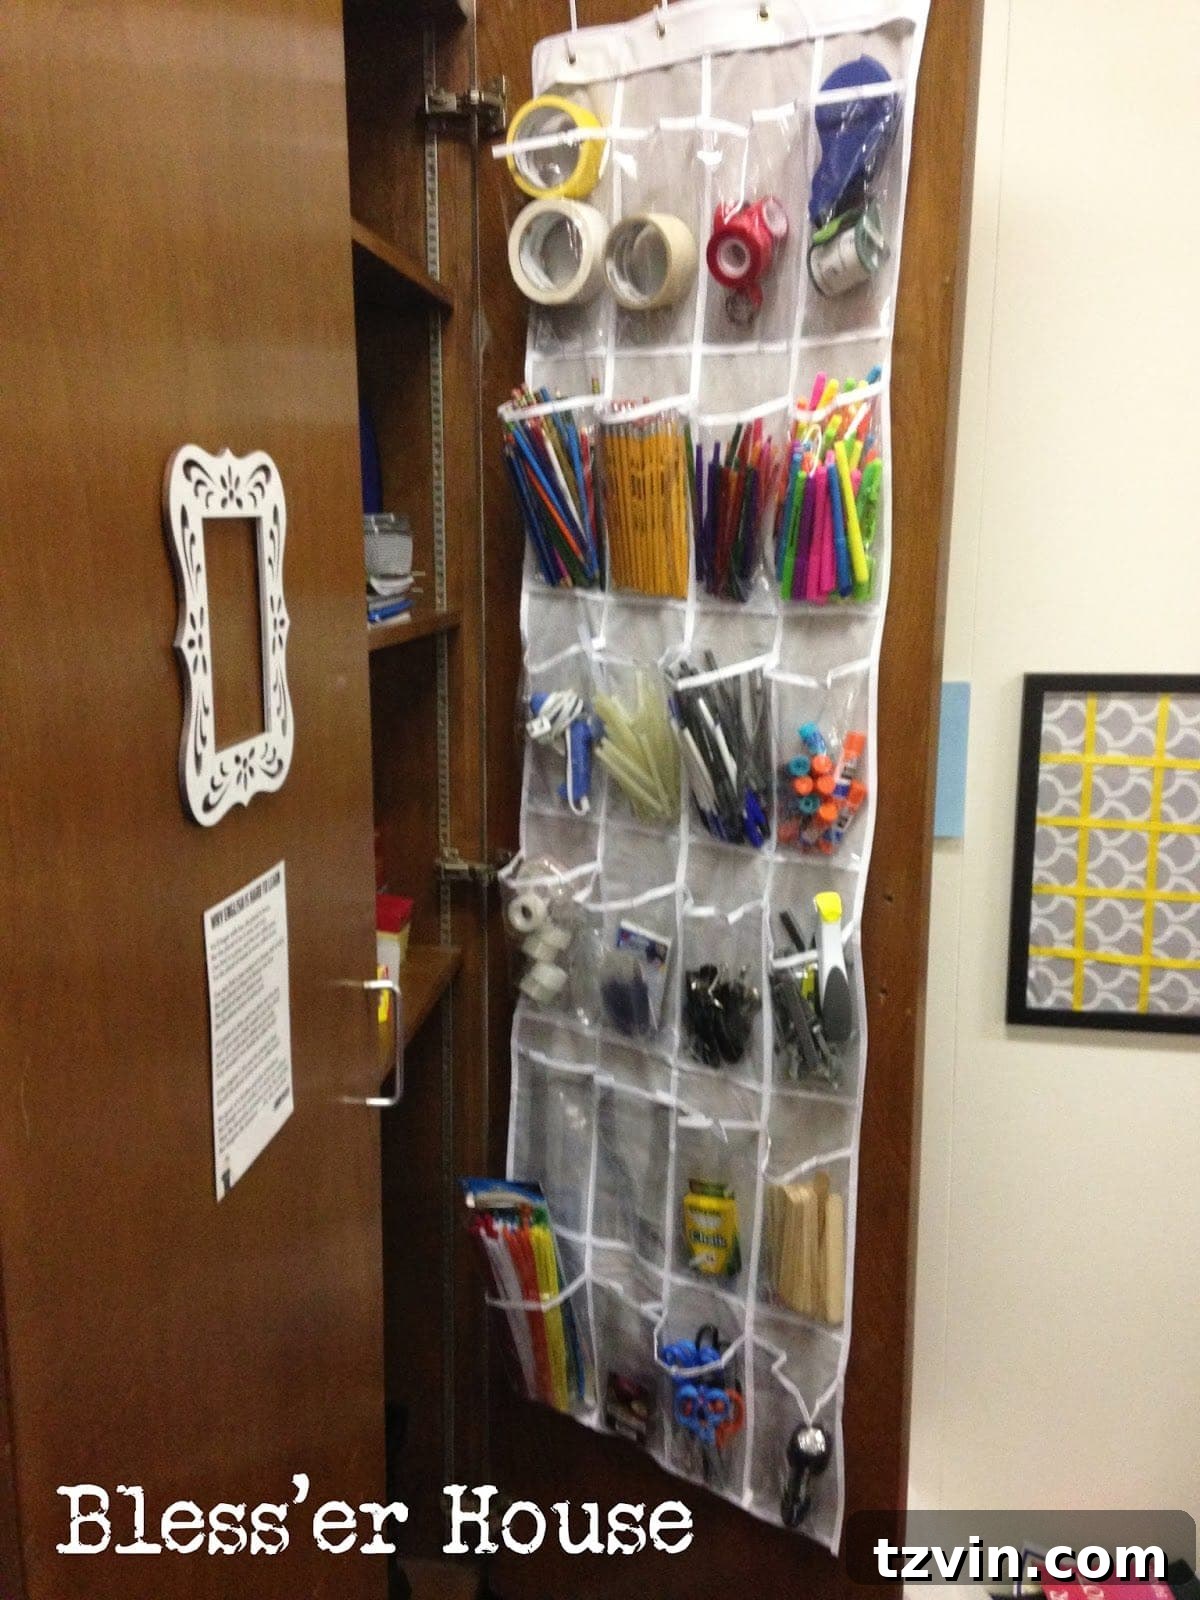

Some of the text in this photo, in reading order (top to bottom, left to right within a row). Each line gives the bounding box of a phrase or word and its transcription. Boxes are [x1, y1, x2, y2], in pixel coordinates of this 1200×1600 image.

[210, 909, 223, 930] WHY
[224, 896, 244, 921] ENGLISH
[250, 884, 262, 904] HARD
[268, 871, 281, 891] LEARN
